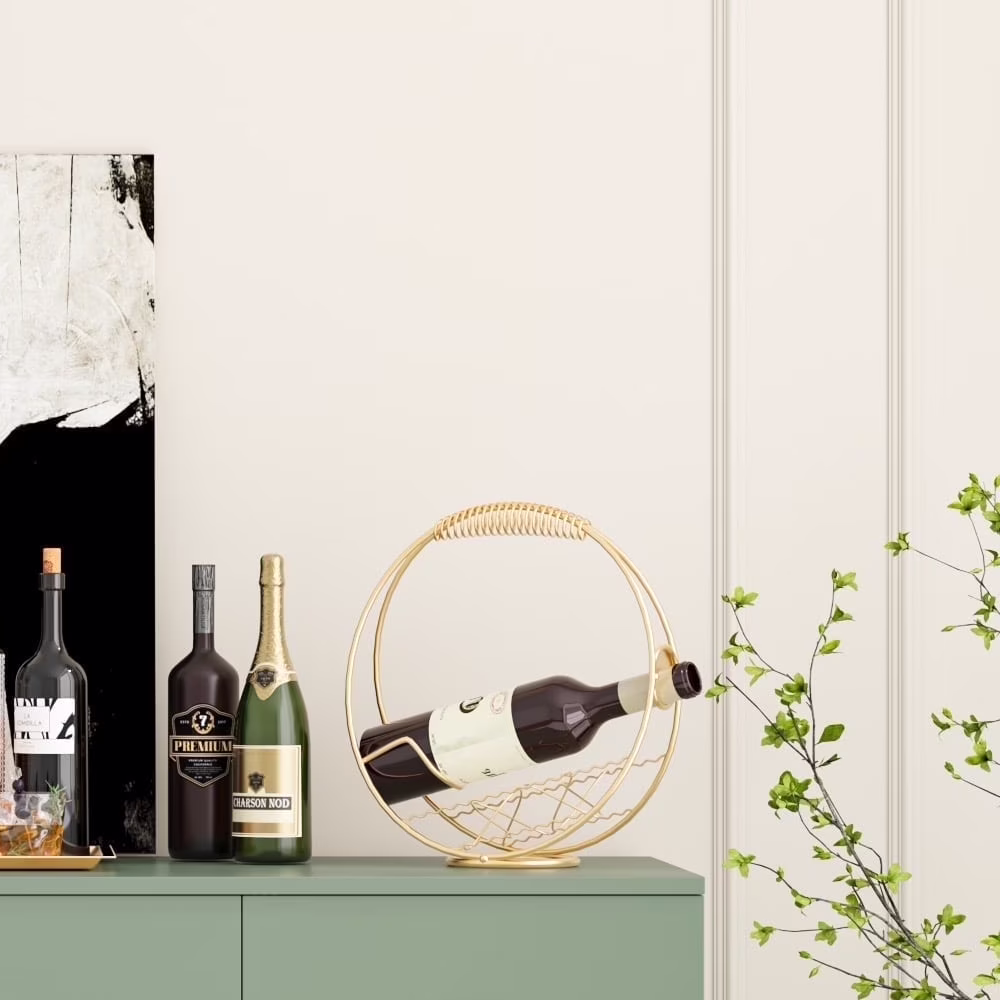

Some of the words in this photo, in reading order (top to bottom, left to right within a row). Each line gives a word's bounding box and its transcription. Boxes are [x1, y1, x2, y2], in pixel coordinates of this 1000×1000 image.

[199, 714, 208, 727] 7
[174, 740, 233, 752] PREMIUM
[233, 797, 267, 809] CHARSON
[268, 798, 290, 809] NOD
